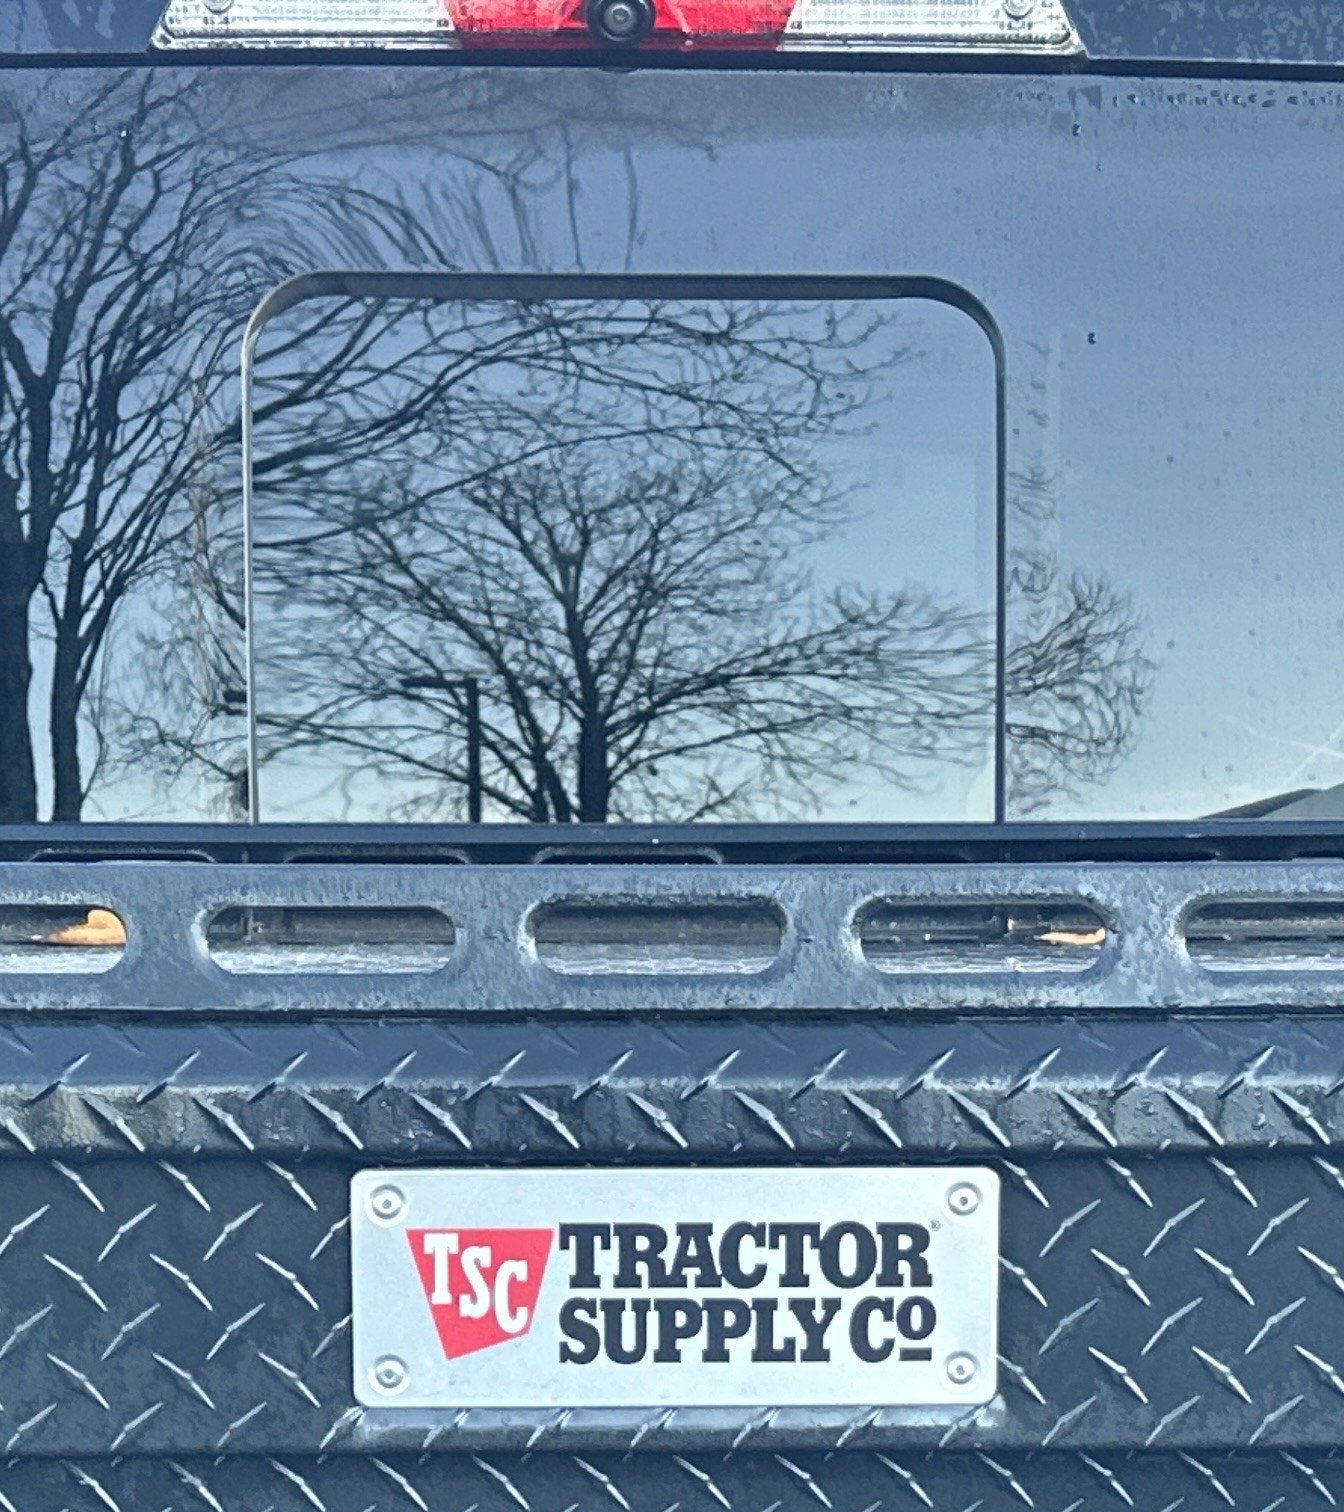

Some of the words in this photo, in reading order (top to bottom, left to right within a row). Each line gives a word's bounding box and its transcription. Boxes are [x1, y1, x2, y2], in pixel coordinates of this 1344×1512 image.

[423, 1232, 529, 1334] TSC
[558, 1221, 933, 1289] TRACTOR
[558, 1296, 843, 1365] SUPPLY
